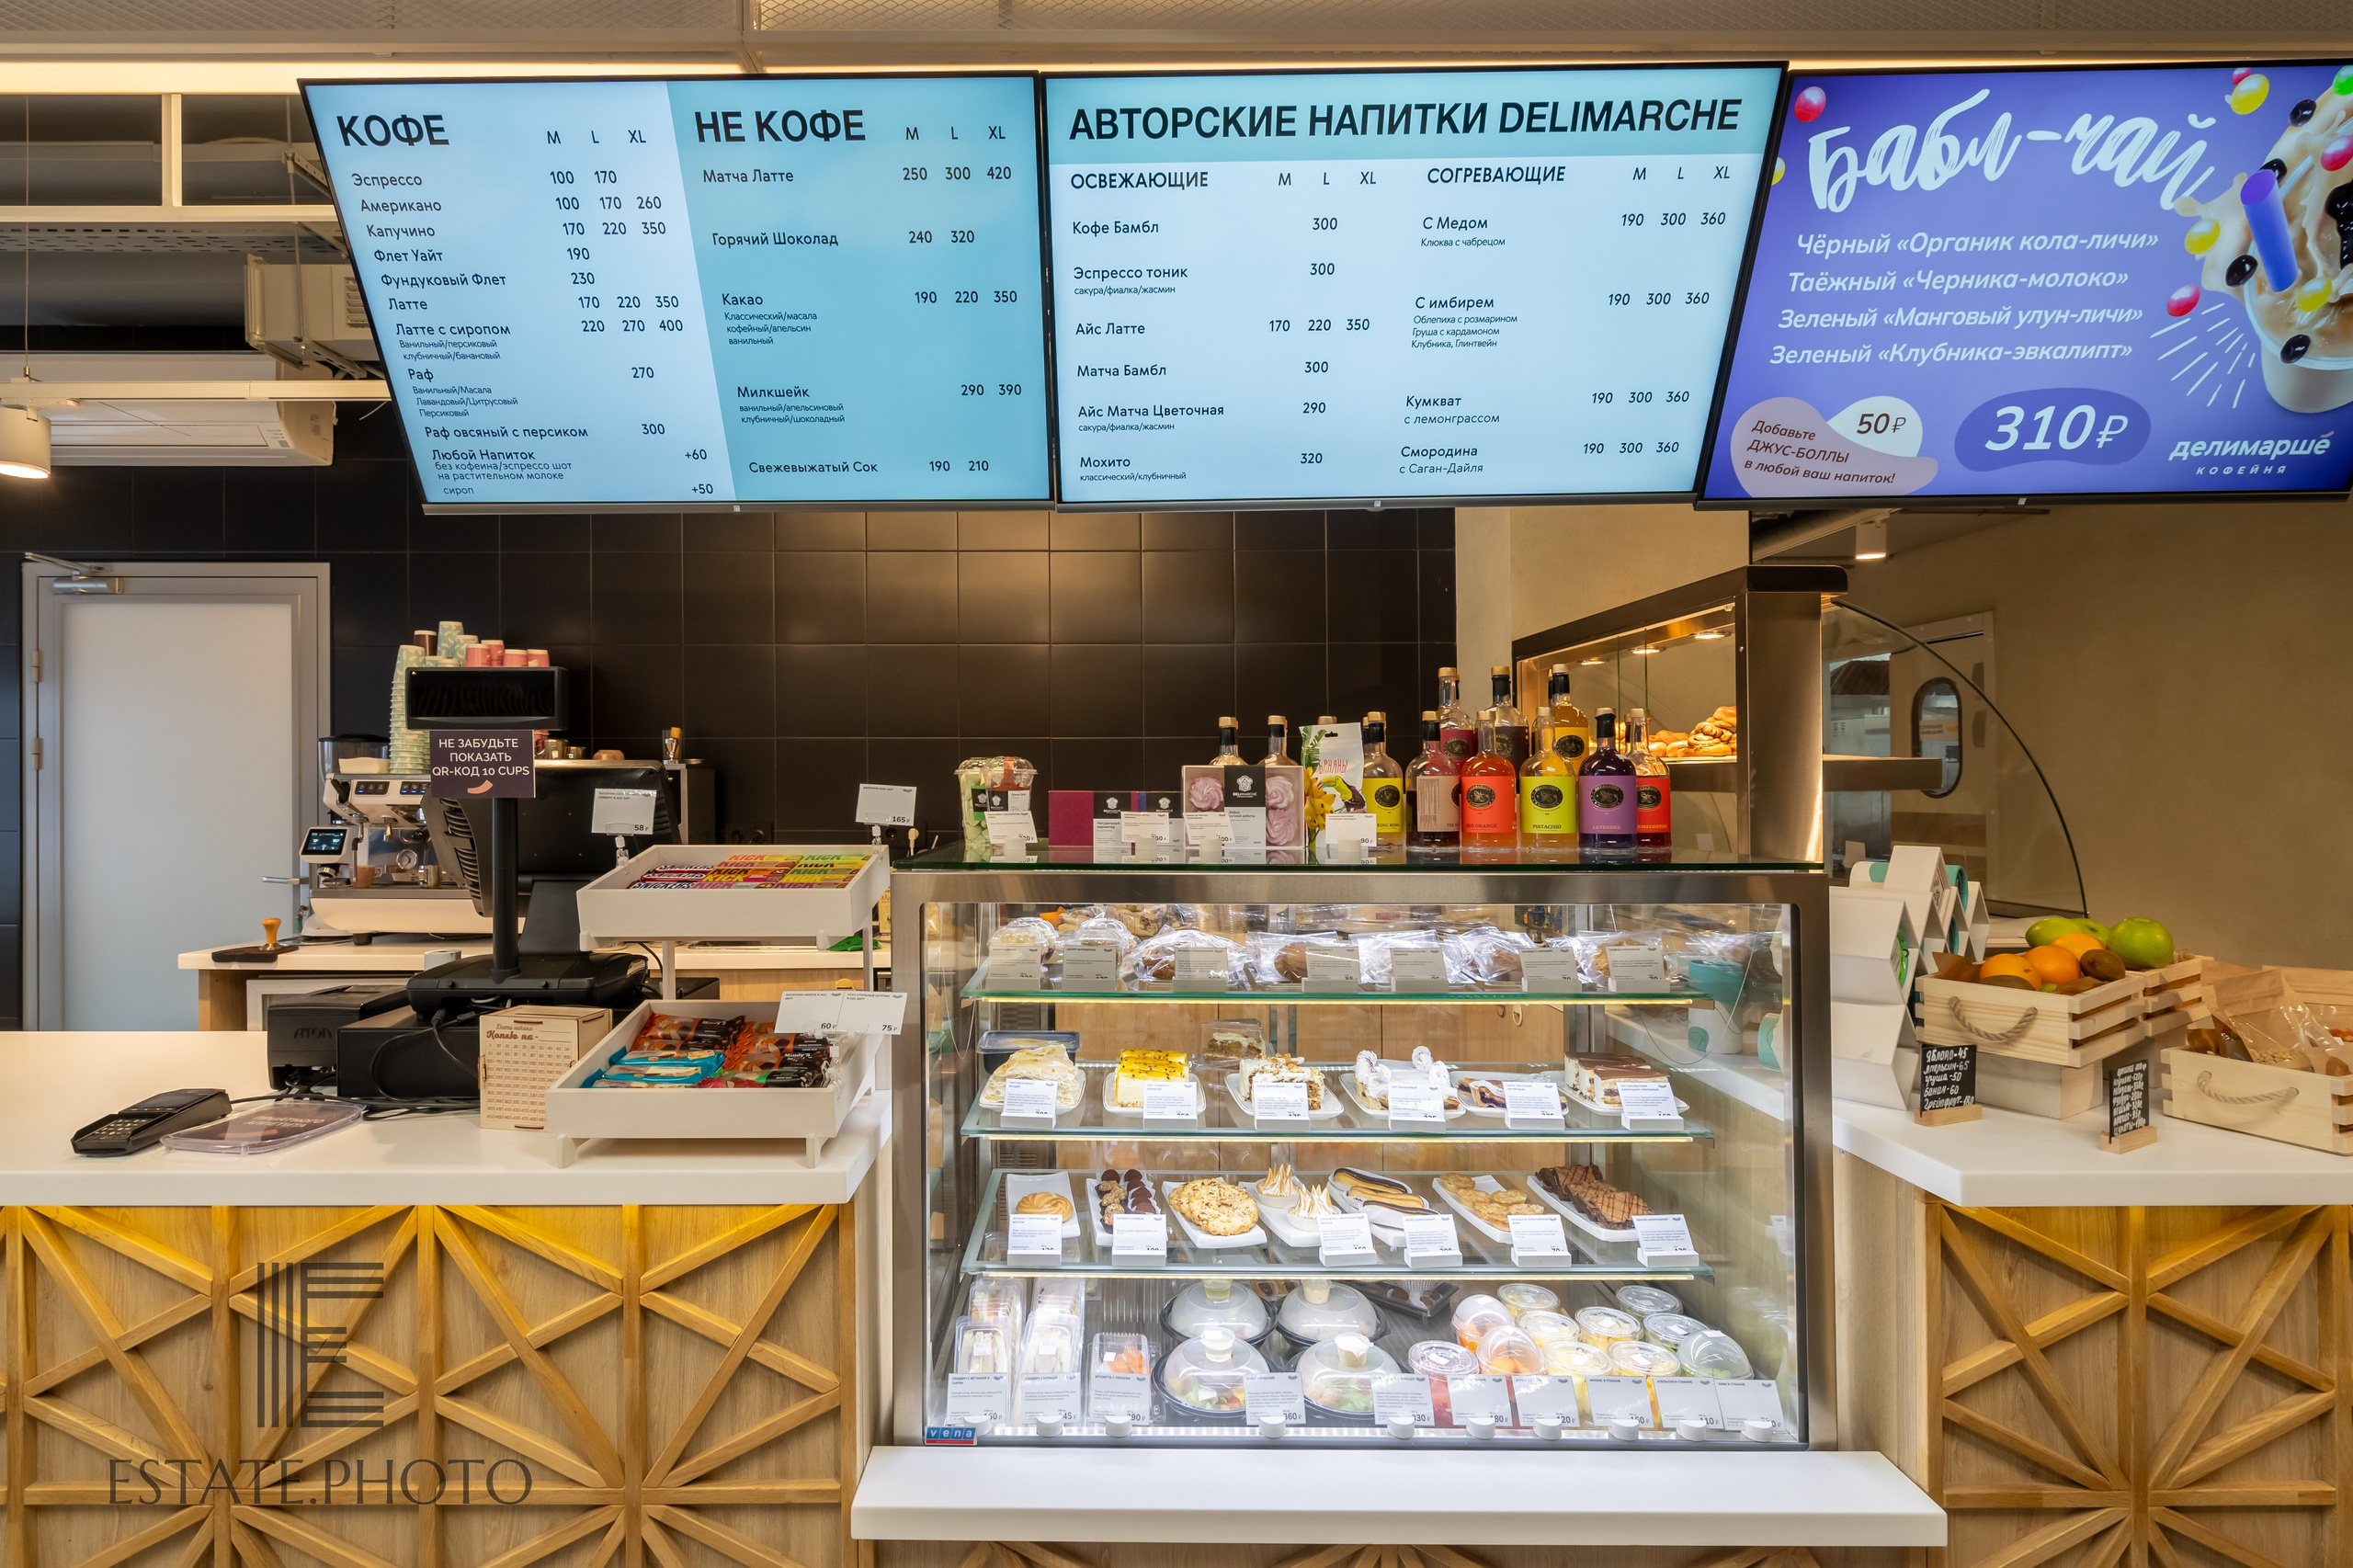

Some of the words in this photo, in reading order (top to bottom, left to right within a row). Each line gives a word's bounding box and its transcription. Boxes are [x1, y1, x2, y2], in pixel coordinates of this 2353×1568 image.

[1069, 106, 1296, 140] АВТОРСКИЕ
[1309, 103, 1487, 136] НАПИТКИ
[1499, 99, 1743, 132] DELIMARCHE
[336, 114, 449, 146] КОФЕ
[695, 111, 745, 142] НЕ
[756, 110, 866, 142] КОФЕ
[547, 131, 561, 143] M
[591, 131, 599, 143] L
[628, 130, 646, 143] XL
[351, 173, 422, 189] Эспрессо
[550, 171, 574, 184] 100
[594, 171, 617, 184] 170
[704, 169, 748, 182] Матча
[752, 169, 794, 182] Латте
[903, 167, 927, 180] 250
[945, 167, 971, 180] 300
[987, 166, 1011, 179] 420
[1427, 165, 1566, 185] СОГРЕВАЮЩИЕ
[1071, 172, 1208, 190] ОСВЕЖАЮЩИЕ
[361, 199, 441, 215] Американо
[555, 197, 579, 210] 100
[599, 197, 621, 210] 170
[636, 197, 662, 210] 260
[1074, 221, 1109, 237] Кофе
[1114, 221, 1158, 233] Бамбл
[1313, 217, 1337, 230] 300
[1437, 217, 1487, 231] Медом
[1621, 213, 1643, 226] 190
[1660, 213, 1686, 226] 300
[1700, 212, 1726, 224] 360
[366, 224, 435, 240] Капучино
[712, 233, 768, 248] Горячий
[773, 232, 838, 246] Шоколад
[1421, 238, 1453, 246] Клюква
[1462, 237, 1506, 247] чабрецом
[1798, 233, 1890, 259] Чёрный
[1897, 233, 2015, 257] «Органик
[2019, 233, 2158, 250] кола-личи»
[374, 250, 408, 261] Флет
[411, 249, 443, 261] Уайт
[1074, 267, 1142, 281] Эспрессо
[1146, 268, 1188, 278] тоник
[381, 274, 469, 289] Фундуковый
[472, 273, 506, 285] Флет
[1789, 271, 1896, 291] Таёжный
[1903, 270, 2129, 294] «Черника-молоко»
[1074, 285, 1175, 296] сакура/фиалка/жасмин
[389, 298, 427, 310] Латте
[722, 293, 763, 305] Какао
[1429, 296, 1494, 311] имбирем
[724, 312, 817, 322] Классический/масала
[1414, 315, 1455, 324] Облепиха
[1464, 316, 1518, 324] розмарином
[1778, 309, 1877, 328] Зеленый
[1884, 306, 2011, 325] «Манговый
[2015, 309, 2143, 329] улун-личи»
[396, 324, 434, 335] Латте
[450, 326, 511, 337] сиропом
[727, 324, 811, 335] кофейный/апельсин
[1075, 324, 1101, 335] Айс
[1106, 323, 1145, 335] Латте
[1413, 328, 1438, 337] Груша
[399, 340, 497, 349] Ванильный/персиковый
[729, 336, 774, 345] ванильный
[1412, 340, 1453, 349] Клубника,
[1456, 339, 1496, 347] Глинтвейн
[403, 351, 500, 361] клубничный/банановый
[1770, 345, 1871, 364] Зеленый
[1879, 342, 2132, 367] «Клубника-эвкалипт»
[408, 369, 434, 382] Раф
[1077, 366, 1120, 377] Матча
[1124, 364, 1165, 376] Бамбл
[413, 386, 492, 395] Ванильный/Масала
[737, 386, 810, 397] Милкшейк
[417, 397, 518, 406] Лавандовый/Цитрусовый
[1406, 395, 1461, 410] Кумкват
[419, 409, 469, 418] Персиковый
[739, 403, 844, 413] ванильный/апельсиновый
[1078, 406, 1103, 417] Айс
[1108, 405, 1149, 416] Матча
[1154, 404, 1223, 417] Цветочная
[741, 415, 845, 425] клубничный/шоколадный
[1414, 415, 1499, 426] лемонграссом
[425, 426, 449, 439] Раф
[454, 426, 508, 437] овсяный
[523, 429, 588, 439] персиком
[1079, 423, 1175, 433] сакура/фиалка/жасмин
[1752, 421, 1816, 440] Добавьте
[433, 449, 476, 460] Любой
[480, 449, 536, 460] Напиток
[685, 449, 707, 460] +60
[1401, 447, 1478, 460] Смородина
[1746, 439, 1849, 463] ДЖУС-БОЛЛЫ
[455, 461, 550, 472] кофеина/эспрессо
[749, 461, 849, 472] Свежевыжатый
[853, 461, 878, 472] Сок
[1081, 457, 1131, 467] Мохито
[1409, 463, 1483, 474] Саган-Дайля
[1755, 462, 1800, 476] любой
[1802, 471, 1831, 480] ваш
[1834, 472, 1895, 483] напиток!
[2196, 464, 2286, 474] КОФЕЙНЯ
[452, 473, 524, 482] растительном
[1081, 472, 1186, 482] классический/клубничный
[442, 487, 474, 496] сироп
[692, 483, 713, 494] +50
[438, 738, 455, 748] НЕ
[458, 738, 518, 749] ЗАБУДЬТЕ
[449, 752, 512, 762] ПОКАЗАТЬ
[432, 766, 480, 777] QR-КОД
[483, 767, 495, 776] 10
[497, 766, 530, 776] CUPS
[634, 824, 644, 832] 58
[930, 1427, 972, 1438] vena
